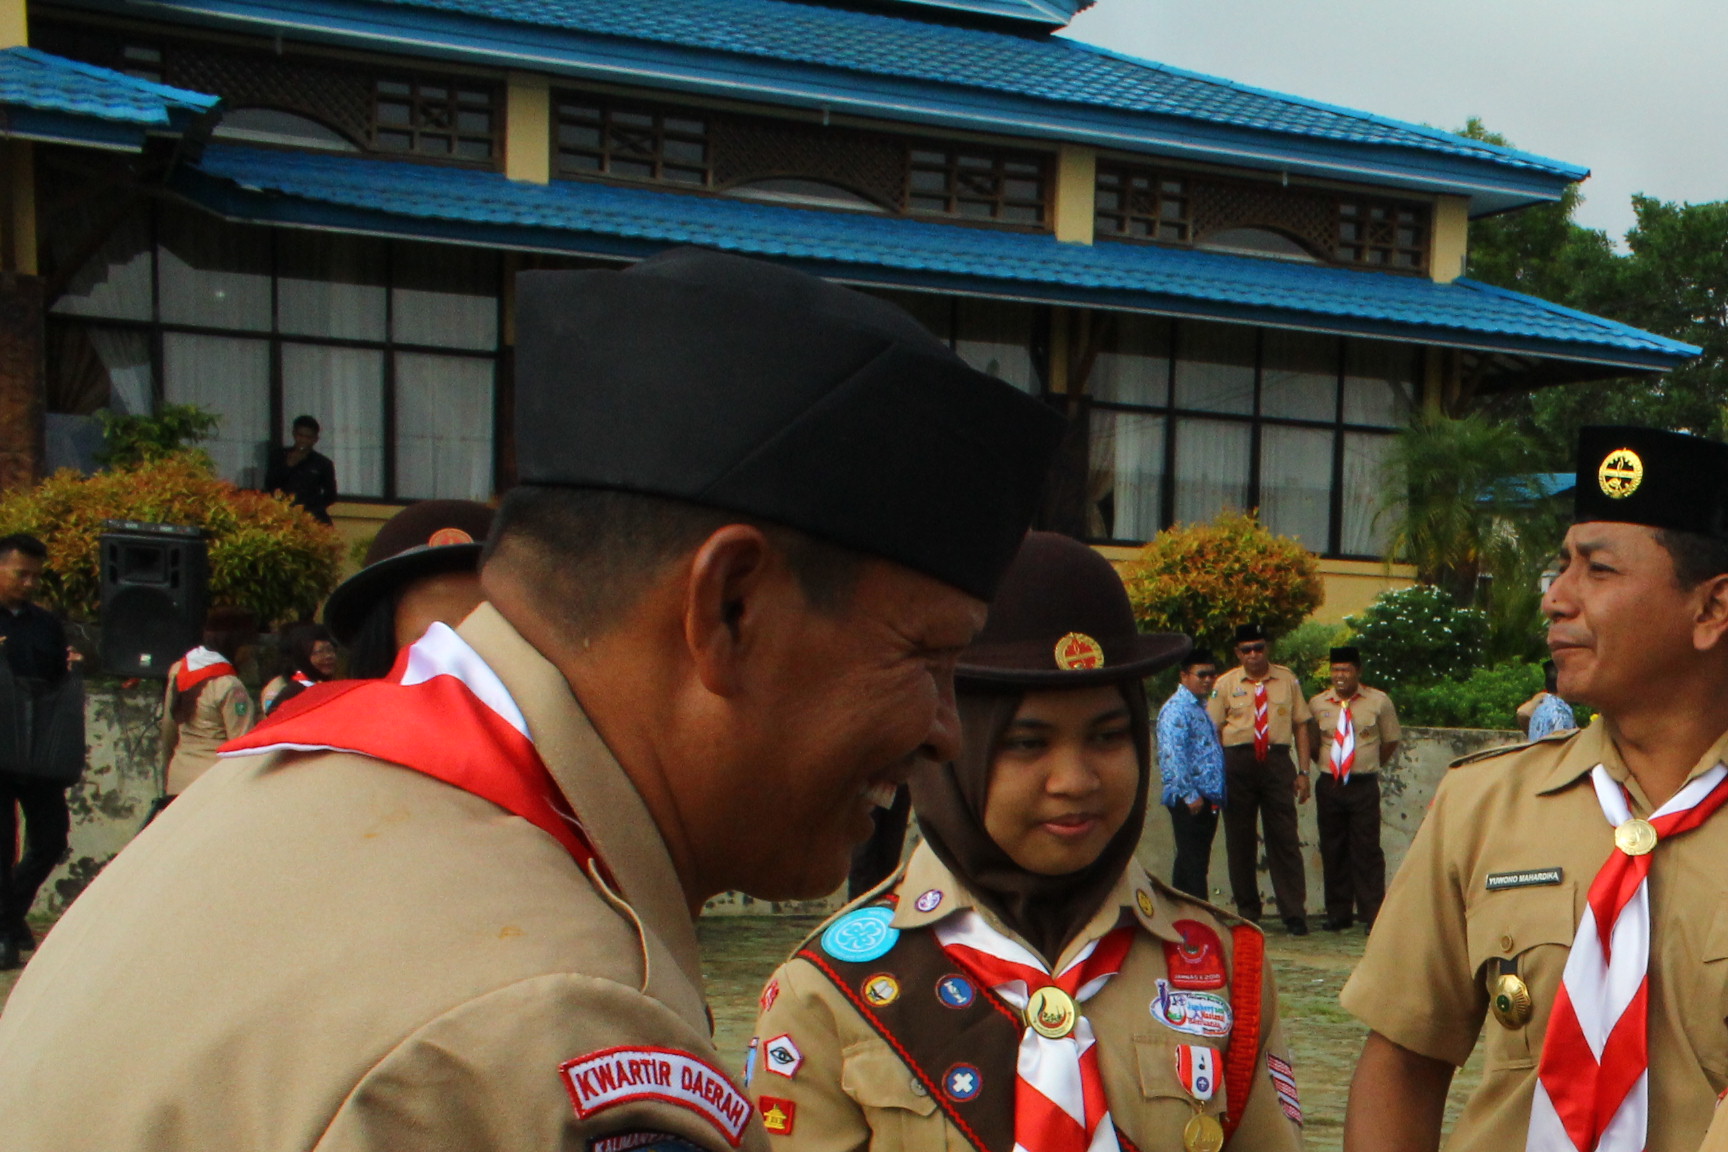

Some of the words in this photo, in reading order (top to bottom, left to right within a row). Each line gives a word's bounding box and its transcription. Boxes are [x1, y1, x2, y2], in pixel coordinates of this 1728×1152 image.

[1489, 875, 1518, 885] YUWONO
[1519, 871, 1560, 882] MAHARDIKA
[575, 1058, 671, 1101] KWARTIR
[681, 1065, 746, 1128] DAERAH
